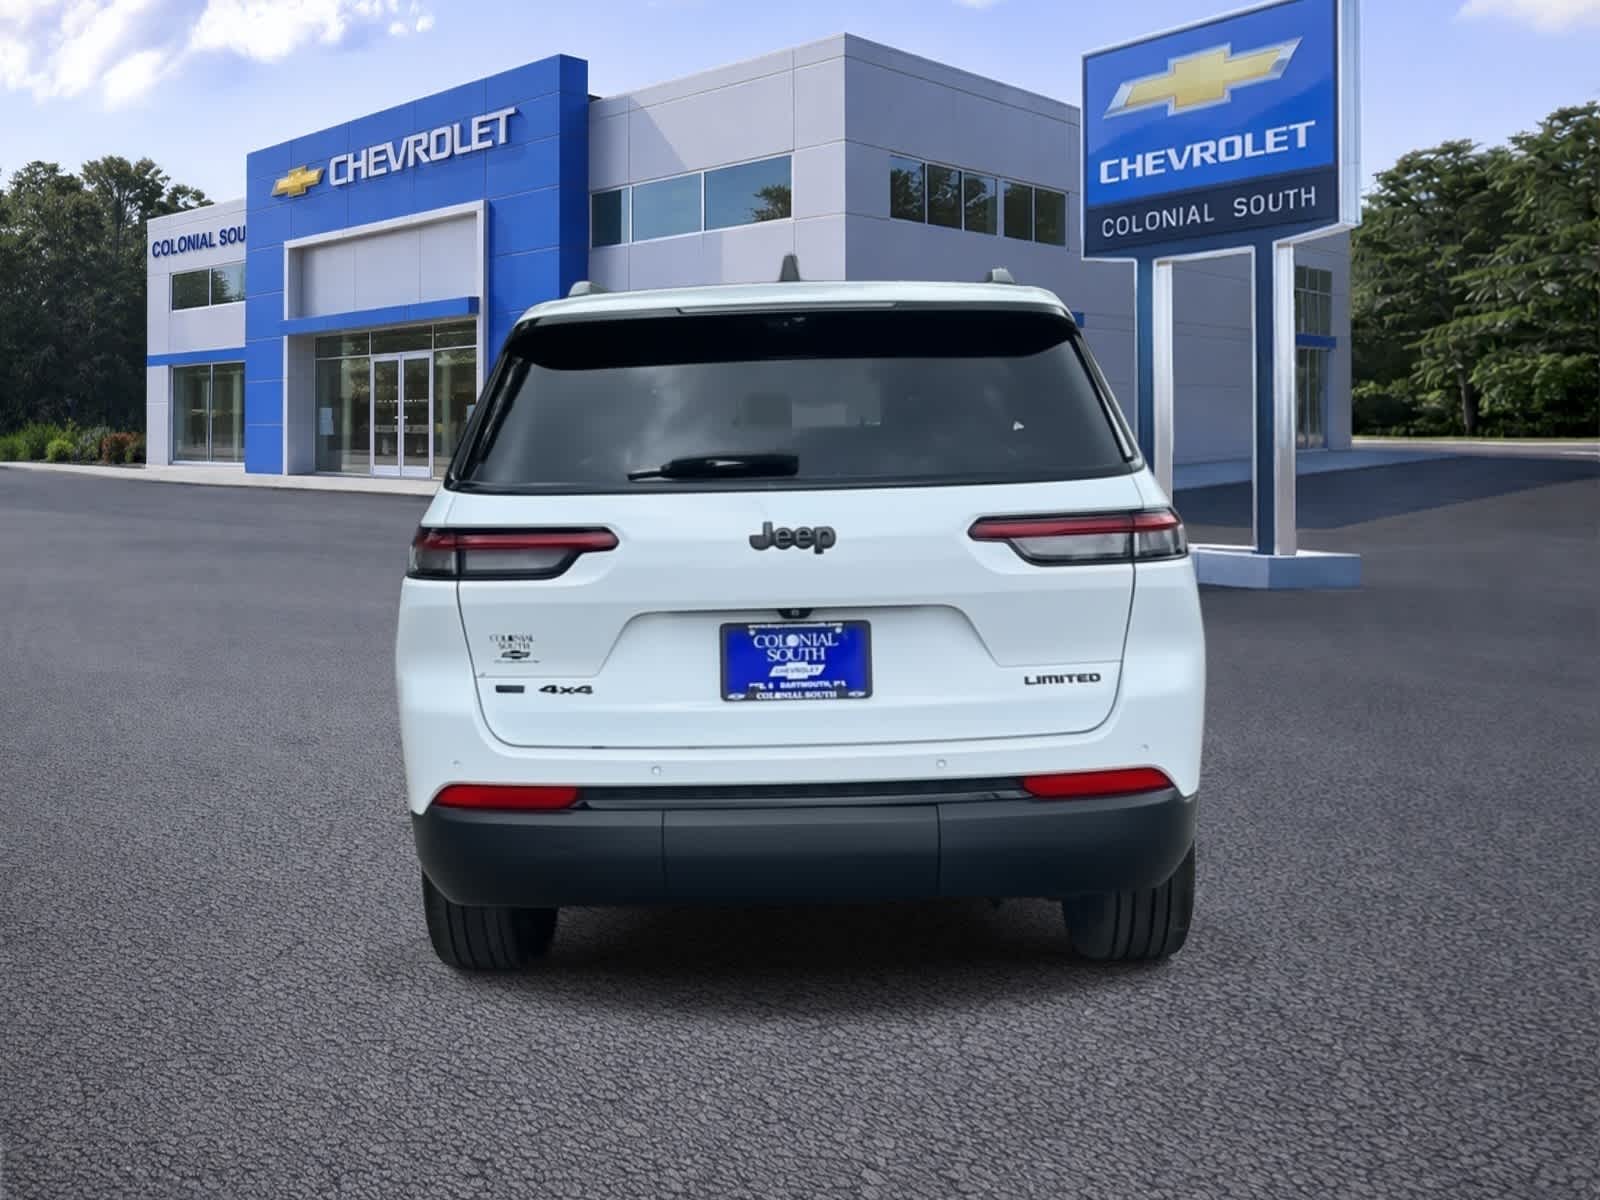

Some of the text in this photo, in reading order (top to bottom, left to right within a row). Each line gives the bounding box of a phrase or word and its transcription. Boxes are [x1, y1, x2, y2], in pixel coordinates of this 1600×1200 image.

[329, 106, 518, 187] CHEVROLET
[1099, 120, 1316, 185] CHEVROLET
[1102, 186, 1317, 238] COLONIAL SOUTH
[152, 231, 216, 258] COLONIAL
[749, 521, 836, 555] Jeep
[753, 632, 840, 649] COLONIAL
[767, 647, 826, 662] SOUTH
[538, 685, 593, 694] 4x4
[1024, 673, 1101, 685] LIMITED
[756, 690, 837, 699] COLONIAL SOUTH
